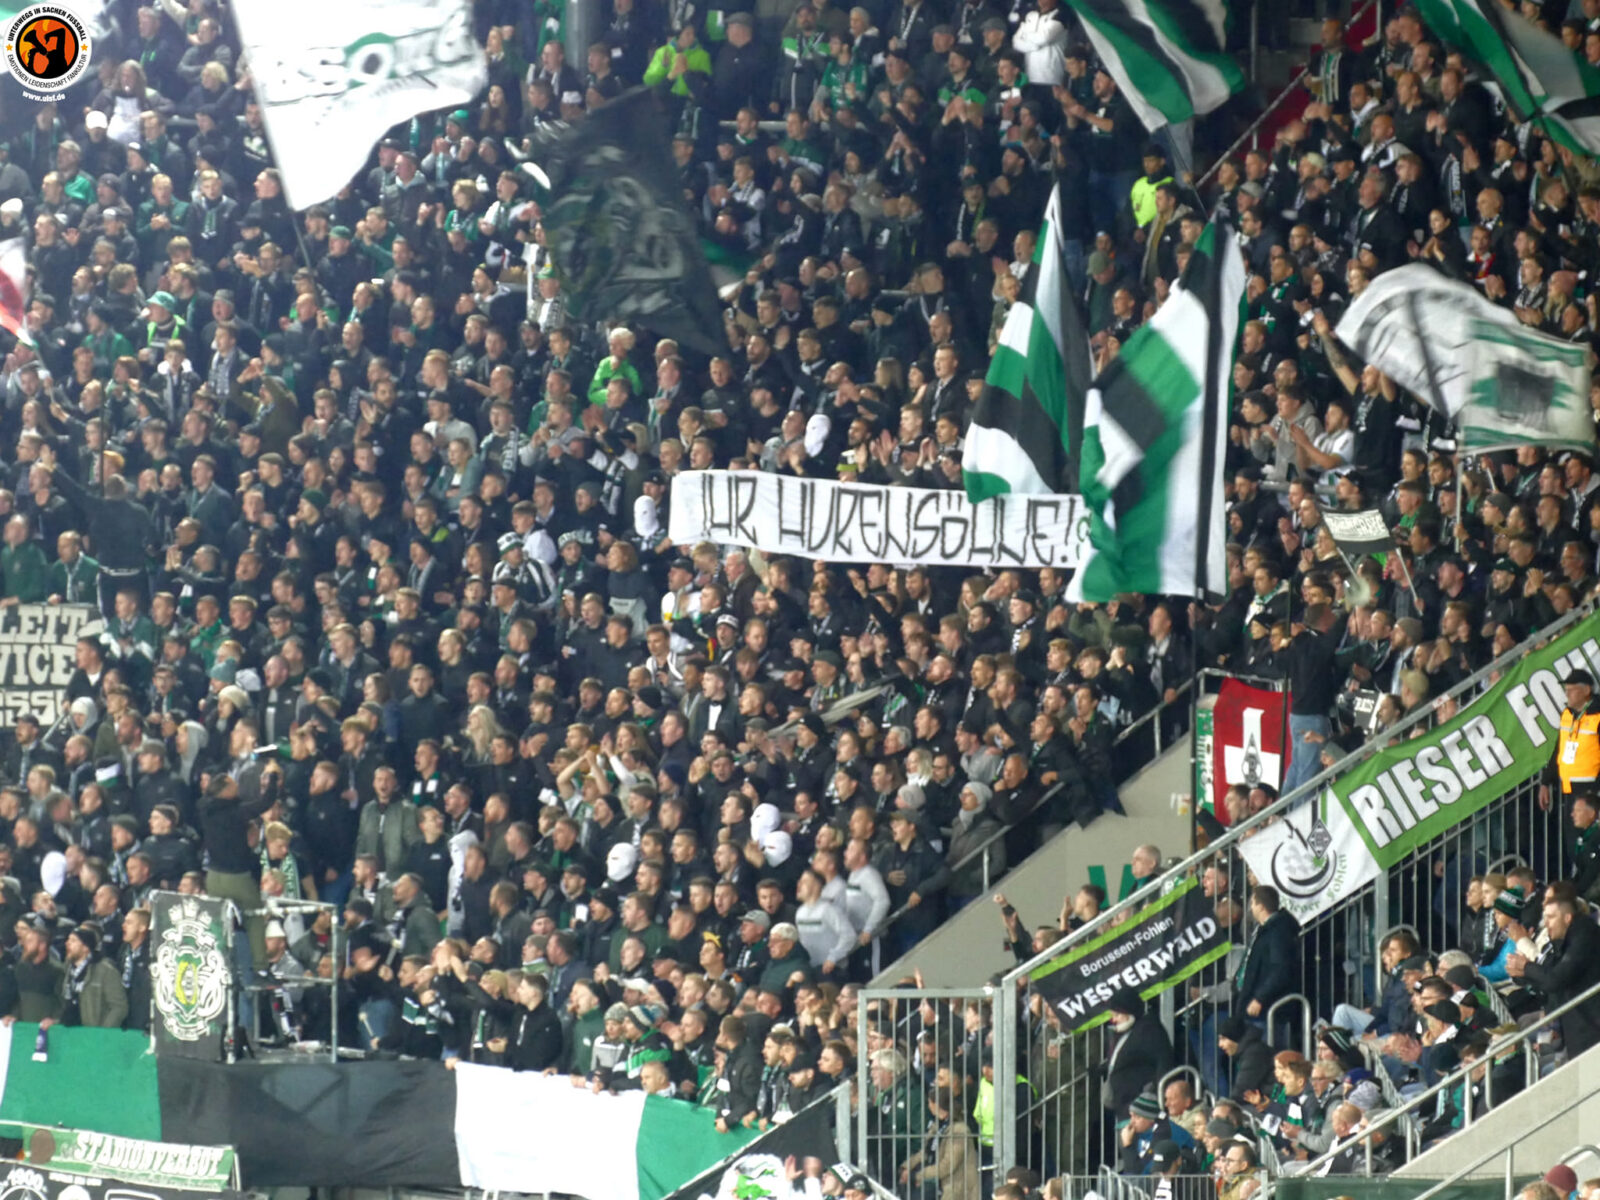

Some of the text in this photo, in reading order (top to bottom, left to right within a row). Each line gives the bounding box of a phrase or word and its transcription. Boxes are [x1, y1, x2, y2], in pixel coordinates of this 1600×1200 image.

[702, 473, 758, 545] IHR
[1348, 714, 1515, 849] RIESER
[1504, 637, 1600, 748] FO
[1057, 916, 1217, 1019] WESTERWALD
[1079, 916, 1174, 978] Borussen-Fohlen
[74, 1131, 225, 1177] STADIONVERBOT
